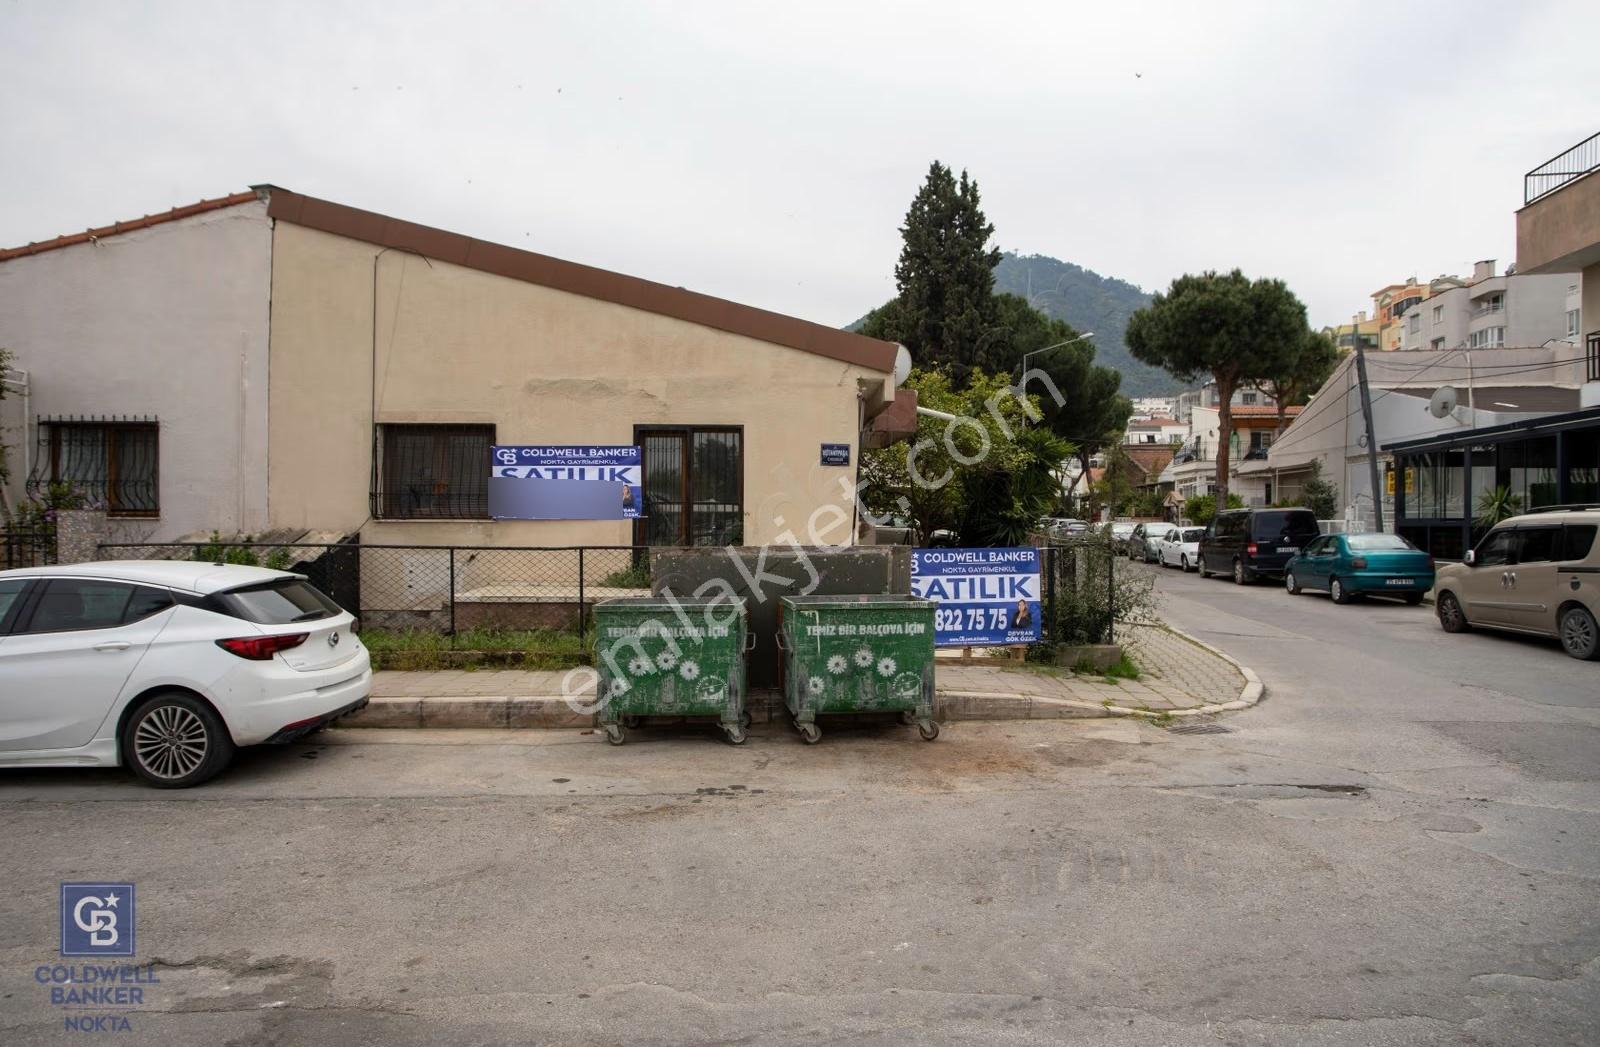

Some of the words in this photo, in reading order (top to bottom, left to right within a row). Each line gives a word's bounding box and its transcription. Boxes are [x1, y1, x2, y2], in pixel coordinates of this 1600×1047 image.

[522, 448, 587, 457] COLDWELL
[589, 448, 637, 457] BANKER
[500, 467, 633, 484] SATILIK
[924, 552, 987, 563] COLDWELL
[989, 551, 1035, 562] BANKER
[911, 576, 1033, 600] SATILIK
[934, 608, 963, 632] 822
[966, 608, 985, 631] 75
[988, 607, 1008, 631] 75
[806, 625, 836, 637] TEMİZ
[838, 623, 857, 636] BİR
[859, 623, 904, 637] BALÇOVA
[904, 621, 925, 637] İÇİN
